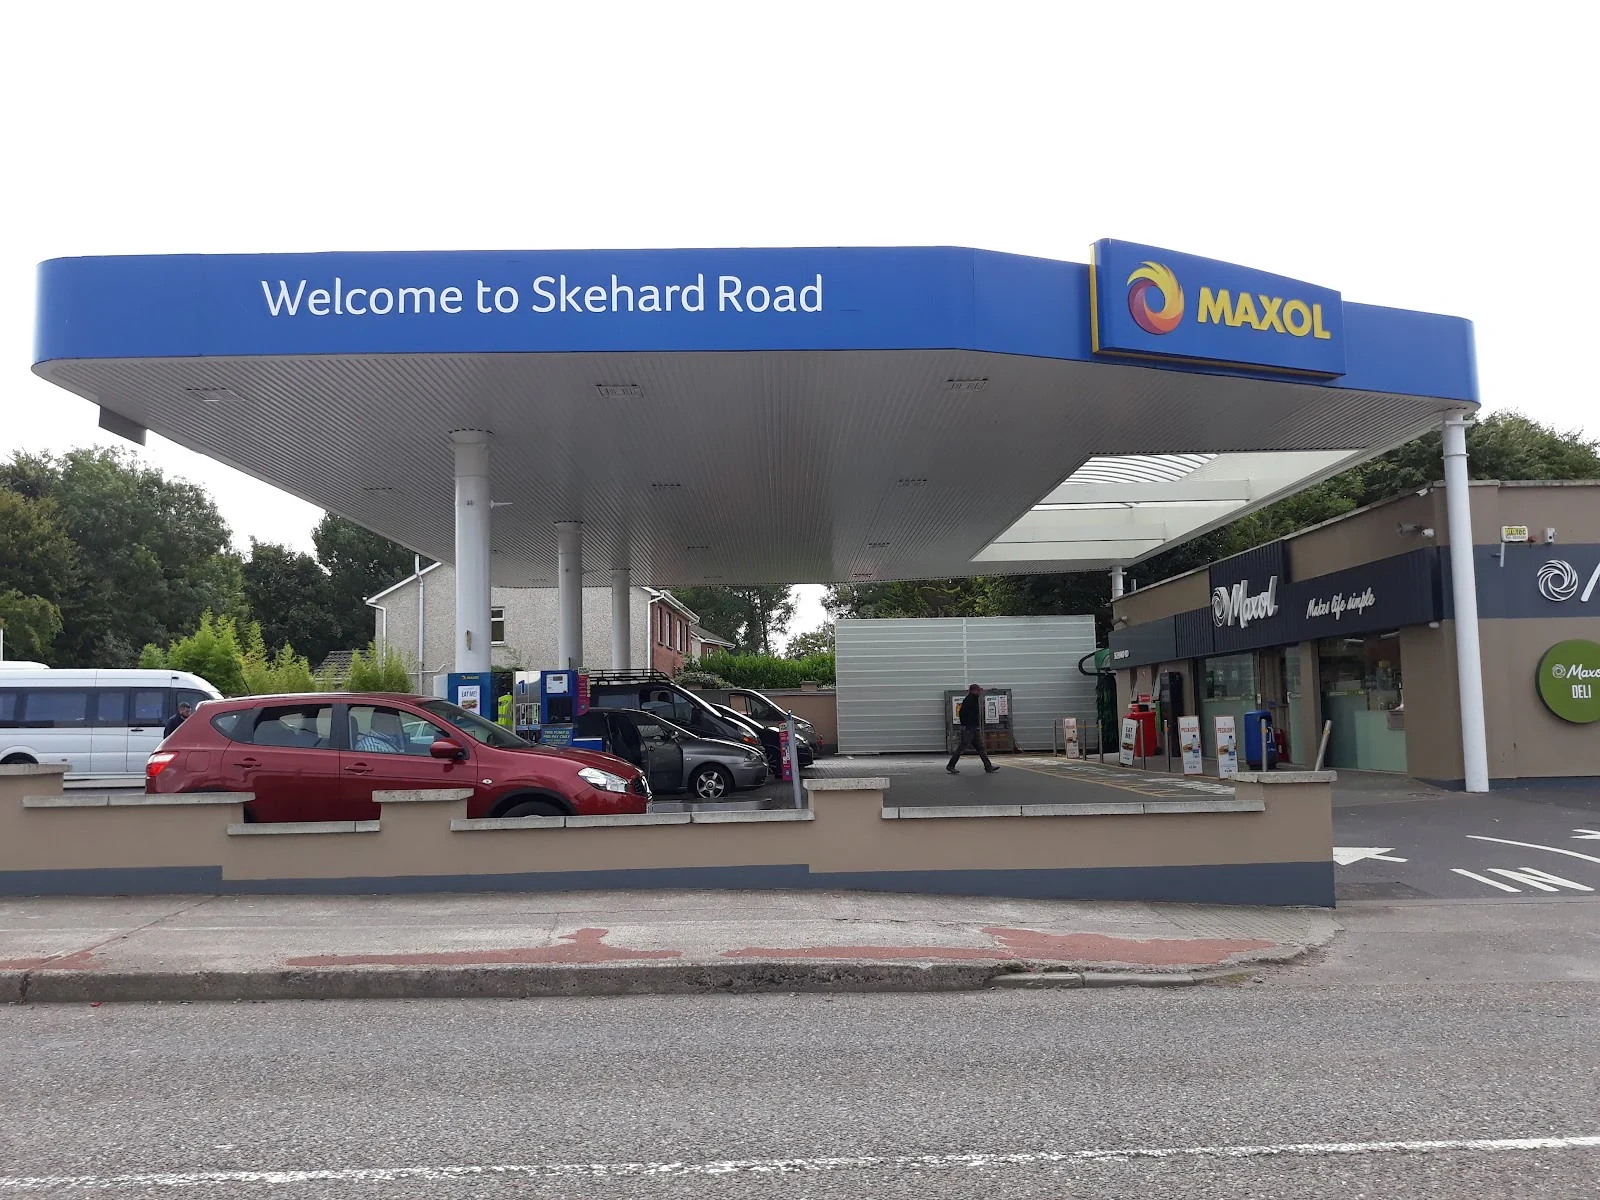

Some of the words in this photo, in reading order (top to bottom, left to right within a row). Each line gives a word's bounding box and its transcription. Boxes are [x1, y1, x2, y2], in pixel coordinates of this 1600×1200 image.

[261, 277, 463, 316] Welcome
[477, 279, 519, 314] to
[532, 273, 705, 313] Skehard
[718, 273, 823, 313] Road
[1197, 286, 1331, 340] MAXOL
[1228, 575, 1279, 629] Maxol
[1305, 597, 1330, 620] Makes
[1331, 592, 1346, 621] life
[1346, 587, 1376, 616] simple
[518, 679, 525, 694] 1
[1571, 684, 1592, 699] DELI
[1125, 726, 1133, 734] EAT
[1449, 866, 1596, 893] IN
